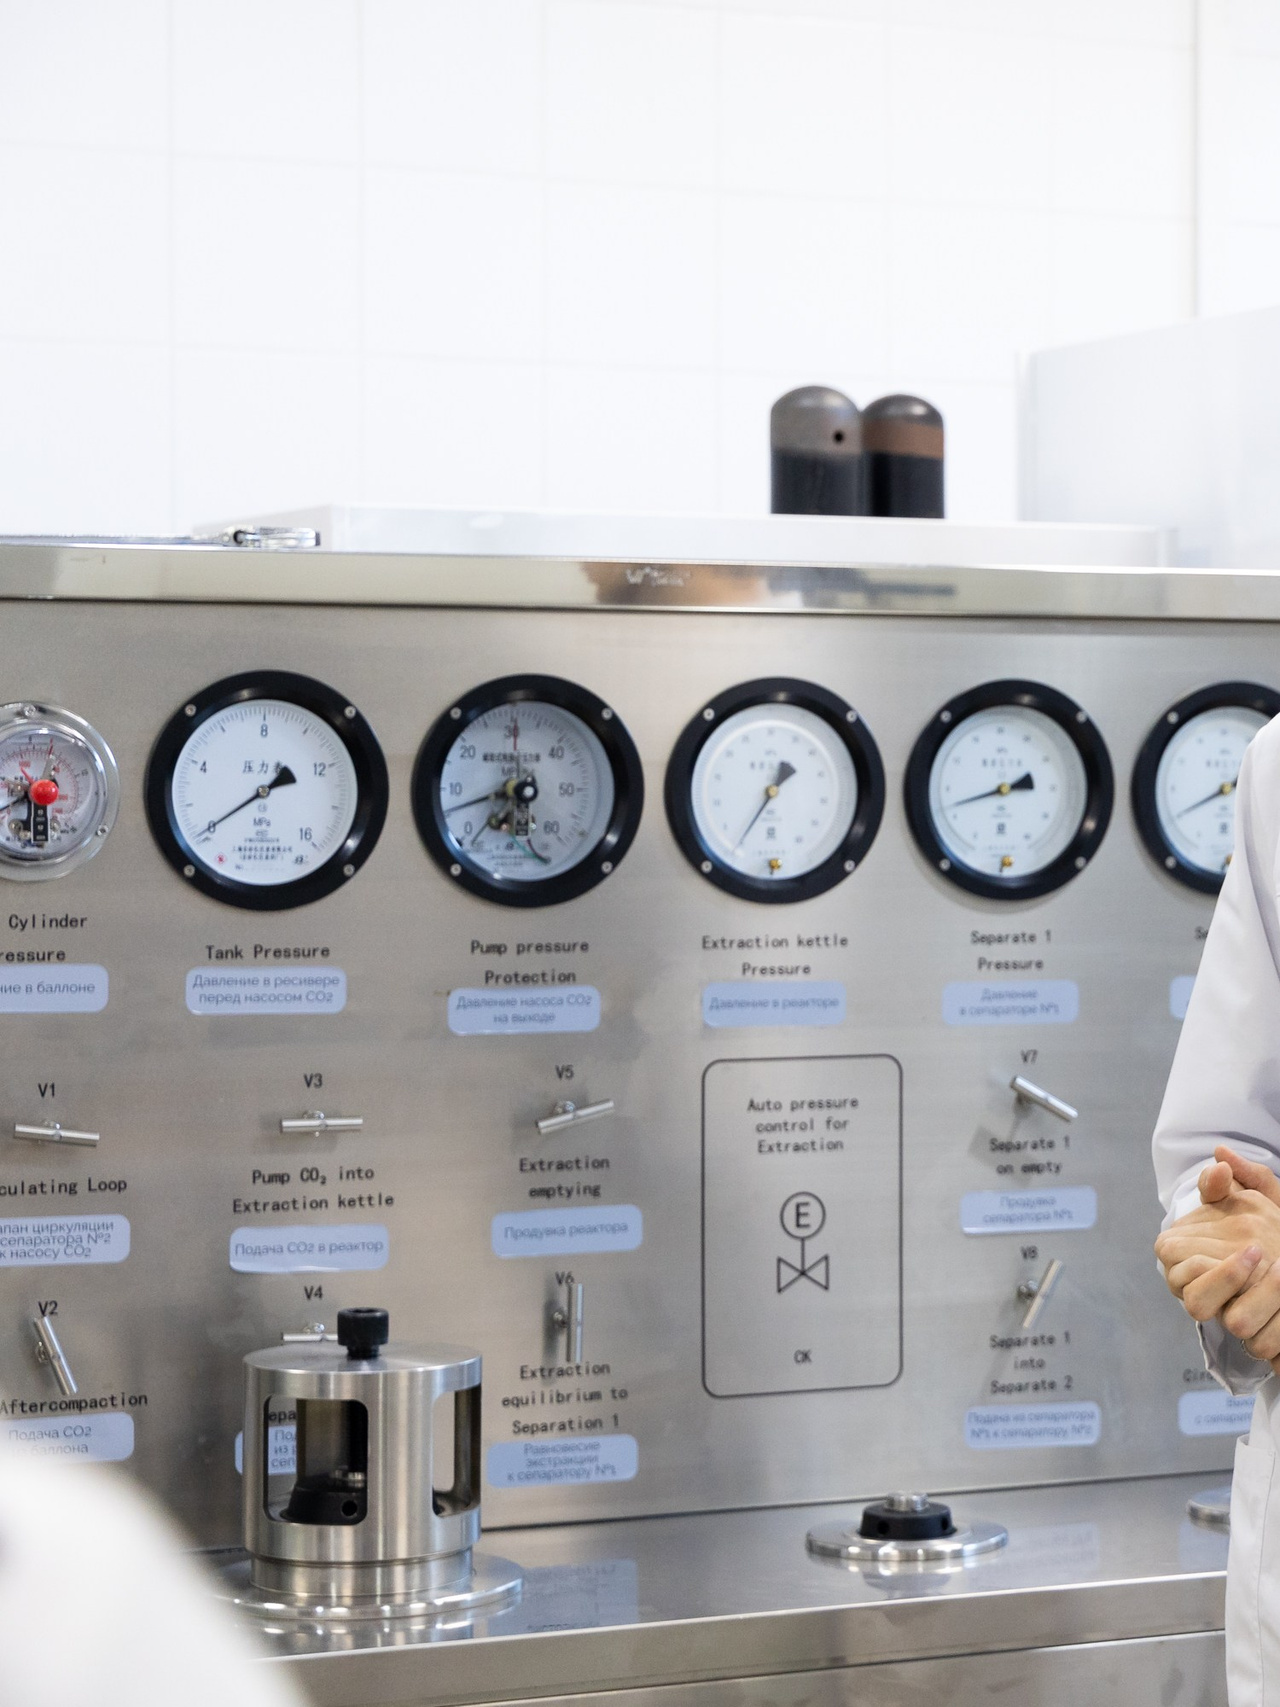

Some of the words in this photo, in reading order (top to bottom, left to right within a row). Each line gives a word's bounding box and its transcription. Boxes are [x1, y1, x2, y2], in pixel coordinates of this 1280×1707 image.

[260, 724, 268, 737] 8
[460, 745, 476, 759] 20
[549, 746, 564, 759] 40
[200, 762, 207, 774] 4
[313, 763, 326, 776] 12
[450, 782, 462, 795] 10
[559, 782, 575, 796] 50
[299, 827, 312, 841] 16
[464, 821, 473, 834] 0
[544, 821, 560, 835] 60
[8, 913, 88, 931] Cylinder
[702, 934, 789, 950] Extraction
[797, 933, 849, 948] kettle
[970, 930, 1037, 945] Separate
[1045, 929, 1052, 942] 1
[205, 944, 244, 960] Tank
[253, 944, 331, 959] Pressure
[470, 939, 508, 956] Pump
[516, 941, 590, 955] pressure
[741, 962, 811, 976] Pressure
[977, 957, 1044, 971] Pressure
[192, 975, 259, 989] Давление
[263, 977, 270, 987] в
[273, 975, 340, 989] ресивере
[484, 969, 577, 985] Protection
[25, 984, 33, 994] в
[37, 981, 95, 994] баллоне
[199, 992, 240, 1005] перед
[244, 992, 303, 1003] насосом
[555, 1065, 574, 1080] V5
[303, 1073, 323, 1089] V3
[38, 1082, 56, 1098] V1
[747, 1098, 782, 1113] Auto
[790, 1097, 859, 1113] pressure
[755, 1118, 815, 1134] control
[826, 1117, 850, 1132] for
[757, 1139, 844, 1154] Extraction
[519, 1156, 610, 1174] Extraction
[252, 1169, 291, 1185] Pump
[339, 1166, 375, 1180] into
[88, 1177, 128, 1193] Loop
[528, 1181, 601, 1200] emptying
[233, 1196, 329, 1214] Extraction
[337, 1192, 395, 1208] kettle
[795, 1202, 811, 1229] E
[32, 1221, 114, 1235] циркуляции
[504, 1225, 566, 1240] Продувка
[569, 1221, 629, 1237] реактора
[0, 1235, 83, 1248] сепаратора
[235, 1243, 284, 1257] Подача
[318, 1244, 326, 1252] в
[329, 1241, 384, 1255] реактор
[10, 1247, 60, 1260] насосу
[555, 1271, 574, 1286] V6
[304, 1285, 323, 1300] V4
[38, 1300, 58, 1317] V2
[794, 1350, 812, 1364] OK
[520, 1363, 611, 1380] Extraction
[0, 1392, 148, 1415] Aftercompaction
[502, 1390, 602, 1409] equilibrium
[610, 1387, 628, 1400] to
[512, 1417, 603, 1435] Separation
[612, 1413, 620, 1427] 1
